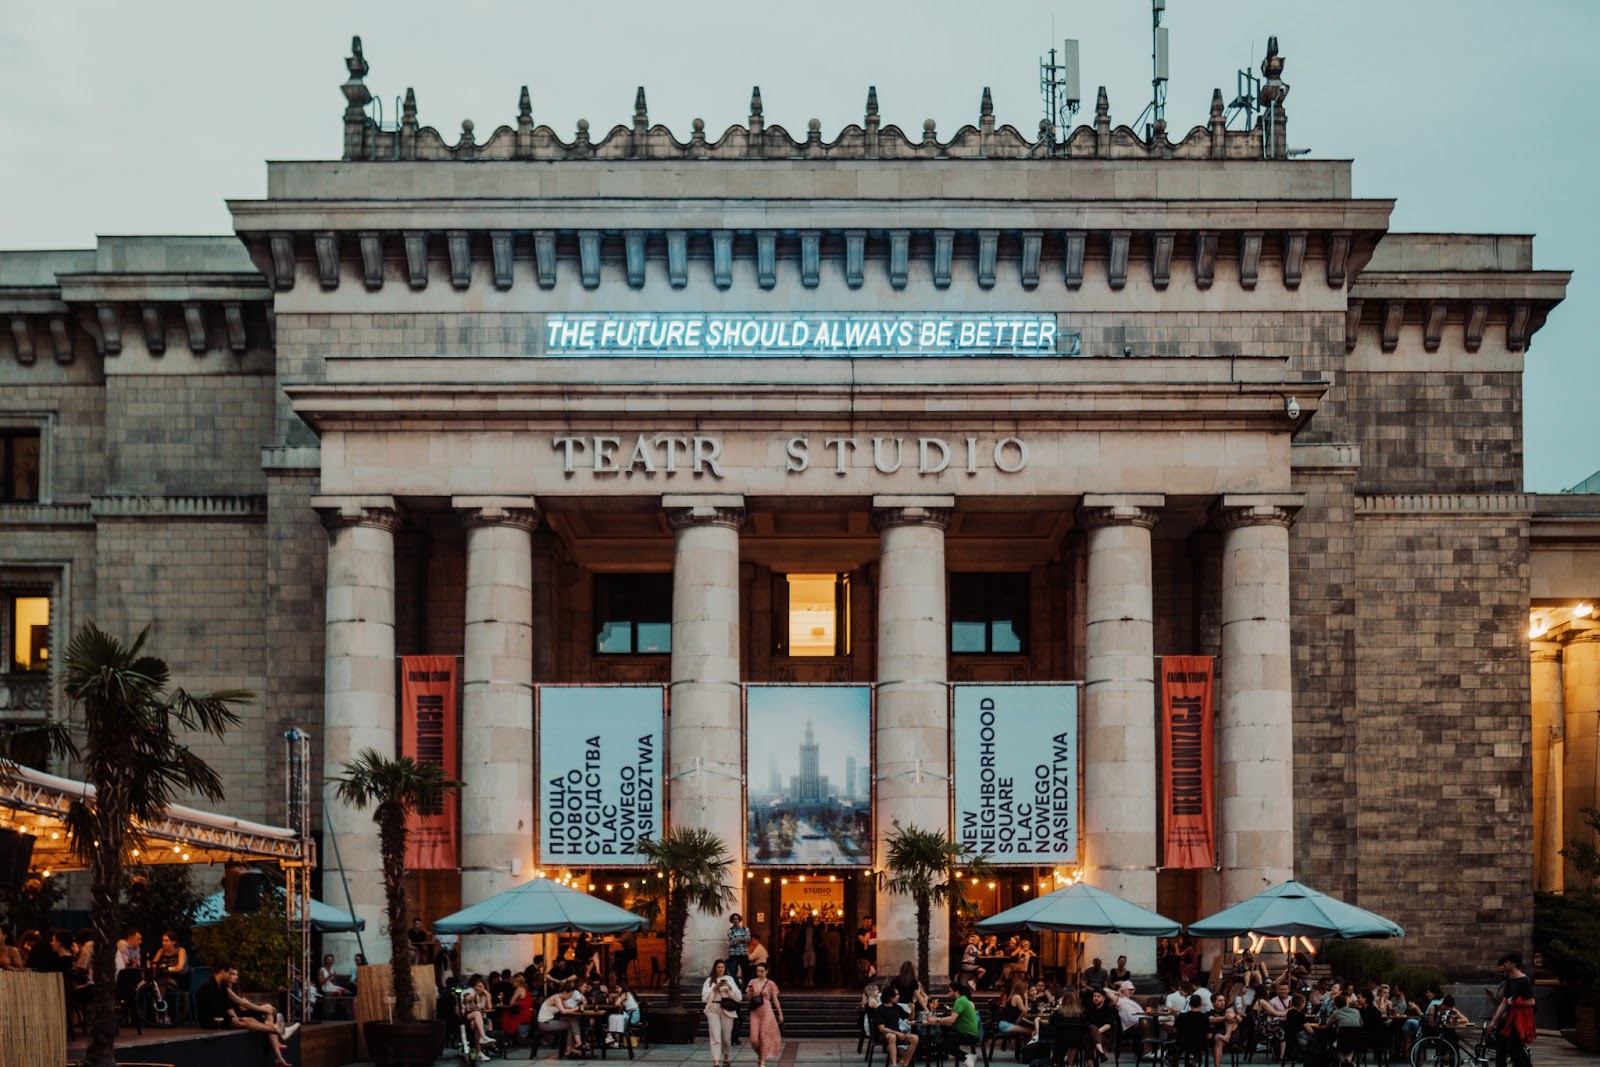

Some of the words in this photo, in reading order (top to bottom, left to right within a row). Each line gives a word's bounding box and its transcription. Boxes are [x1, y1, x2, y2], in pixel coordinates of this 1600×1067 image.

[547, 320, 597, 347] THE
[600, 320, 703, 347] FUTURE
[705, 320, 809, 347] SHOULD
[813, 320, 915, 347] ALWAYS
[920, 320, 954, 347] BE
[959, 320, 1057, 347] BETTER
[553, 434, 724, 477] TEATR
[786, 436, 1030, 475] STUDIO
[585, 735, 602, 855] СУСІДСТВА
[638, 734, 656, 854] ĄSIEDZTWA
[980, 697, 995, 854] NEIGHBORHOOD
[1053, 732, 1071, 853] SĄSIEDZTWA
[1171, 695, 1203, 816] DEKOLONIZACJE
[549, 776, 566, 854] ПЛОЩА
[567, 769, 583, 854] НОВОГО
[602, 804, 617, 855] PLAC
[620, 766, 635, 855] NOWEGO
[963, 811, 978, 854] NEW
[998, 777, 1016, 854] SQUARE
[1017, 803, 1032, 854] PLAC
[1035, 764, 1050, 853] NOWEGO
